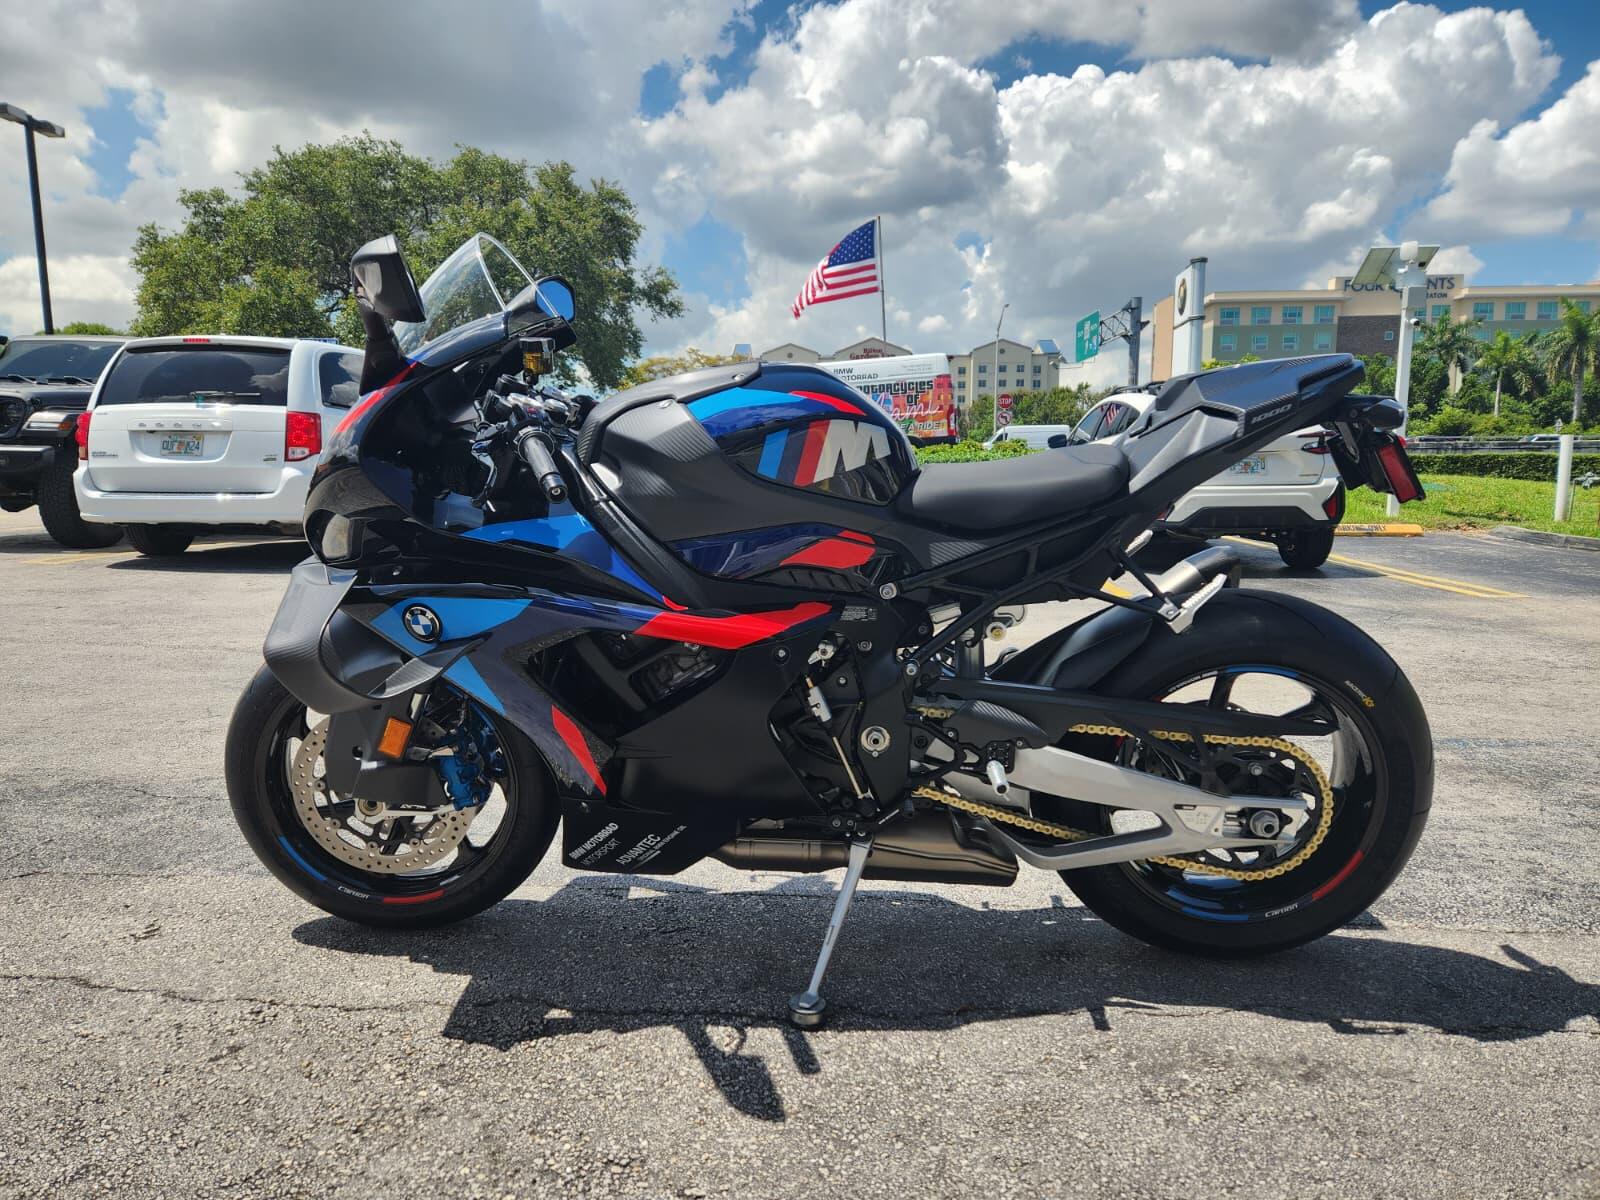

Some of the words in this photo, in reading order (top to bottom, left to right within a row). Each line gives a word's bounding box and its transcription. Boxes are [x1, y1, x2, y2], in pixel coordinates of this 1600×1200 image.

[842, 373, 879, 381] OTORRAD
[582, 822, 619, 851] MOTORRAD
[615, 833, 661, 865] ADVANTEC
